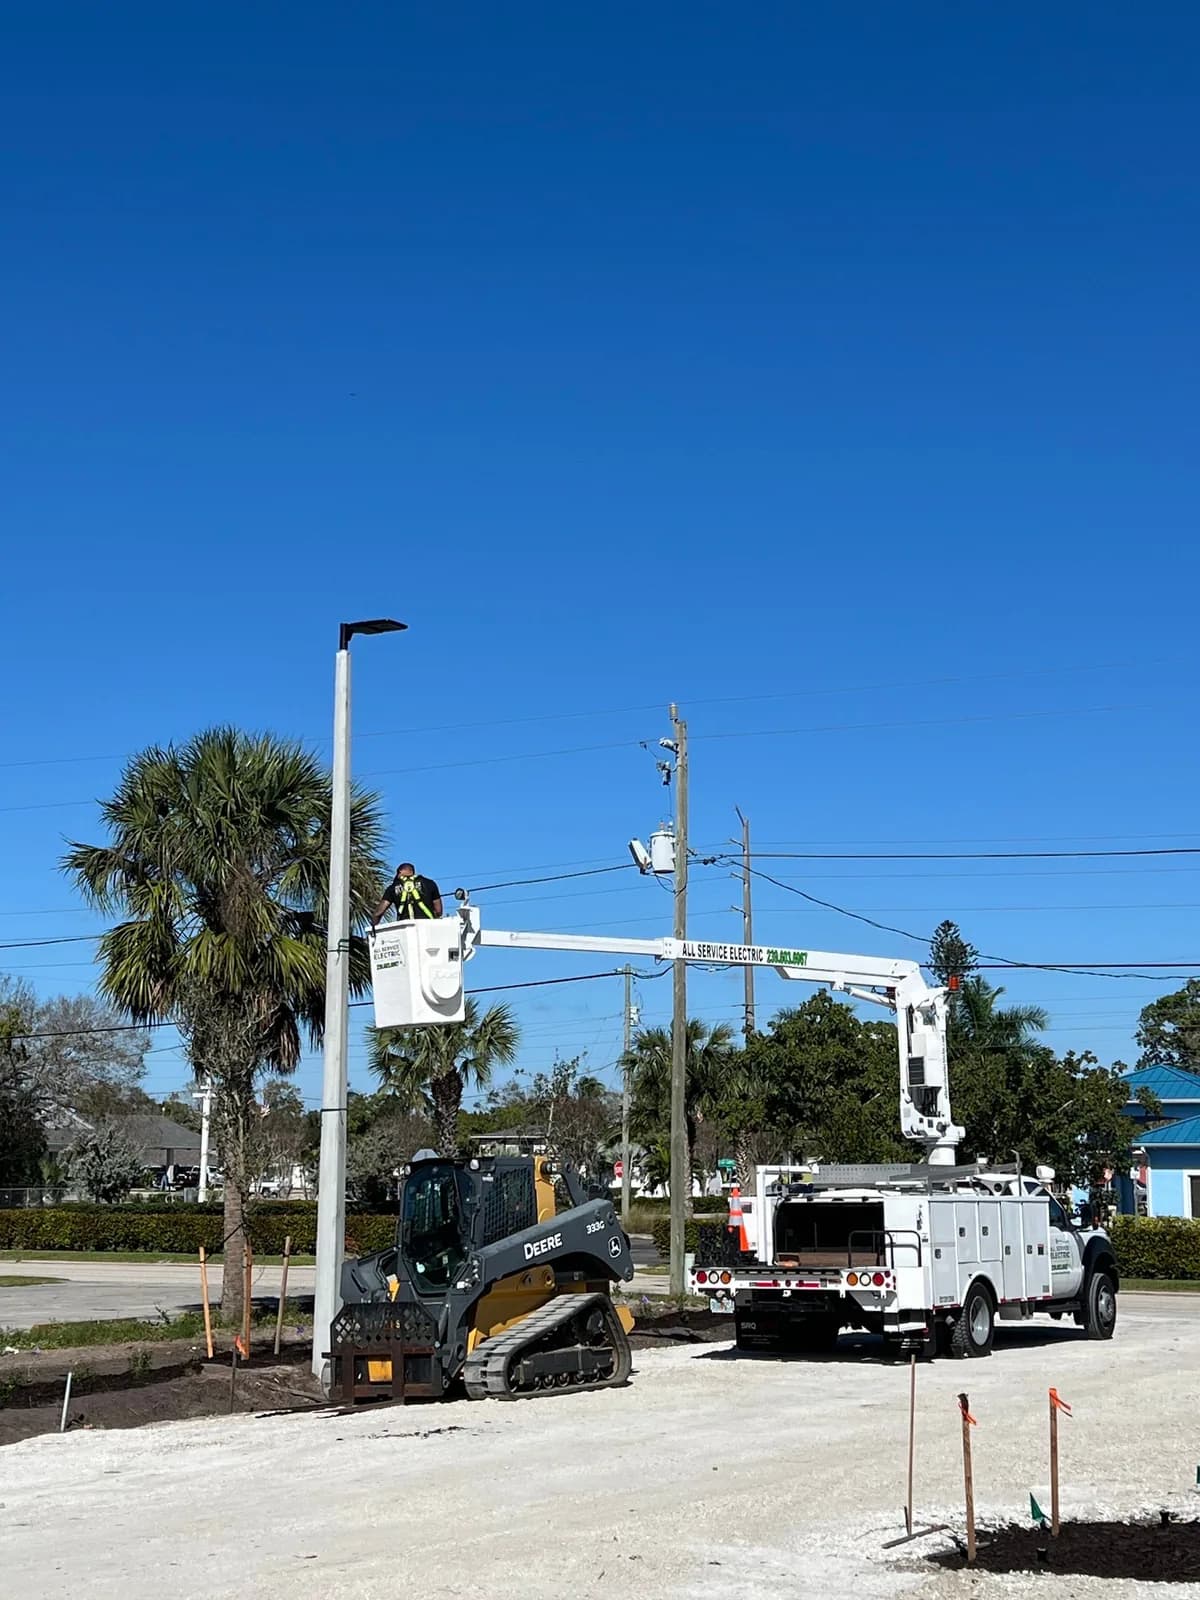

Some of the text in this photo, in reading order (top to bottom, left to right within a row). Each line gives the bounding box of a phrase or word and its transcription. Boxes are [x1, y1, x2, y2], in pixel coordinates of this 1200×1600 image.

[373, 949, 401, 960] ELECTRIC
[682, 942, 696, 958] ALL
[697, 944, 728, 960] SERVICE
[729, 945, 764, 962] ELECTRIC
[585, 1220, 605, 1235] 333G
[523, 1232, 563, 1260] DEERE
